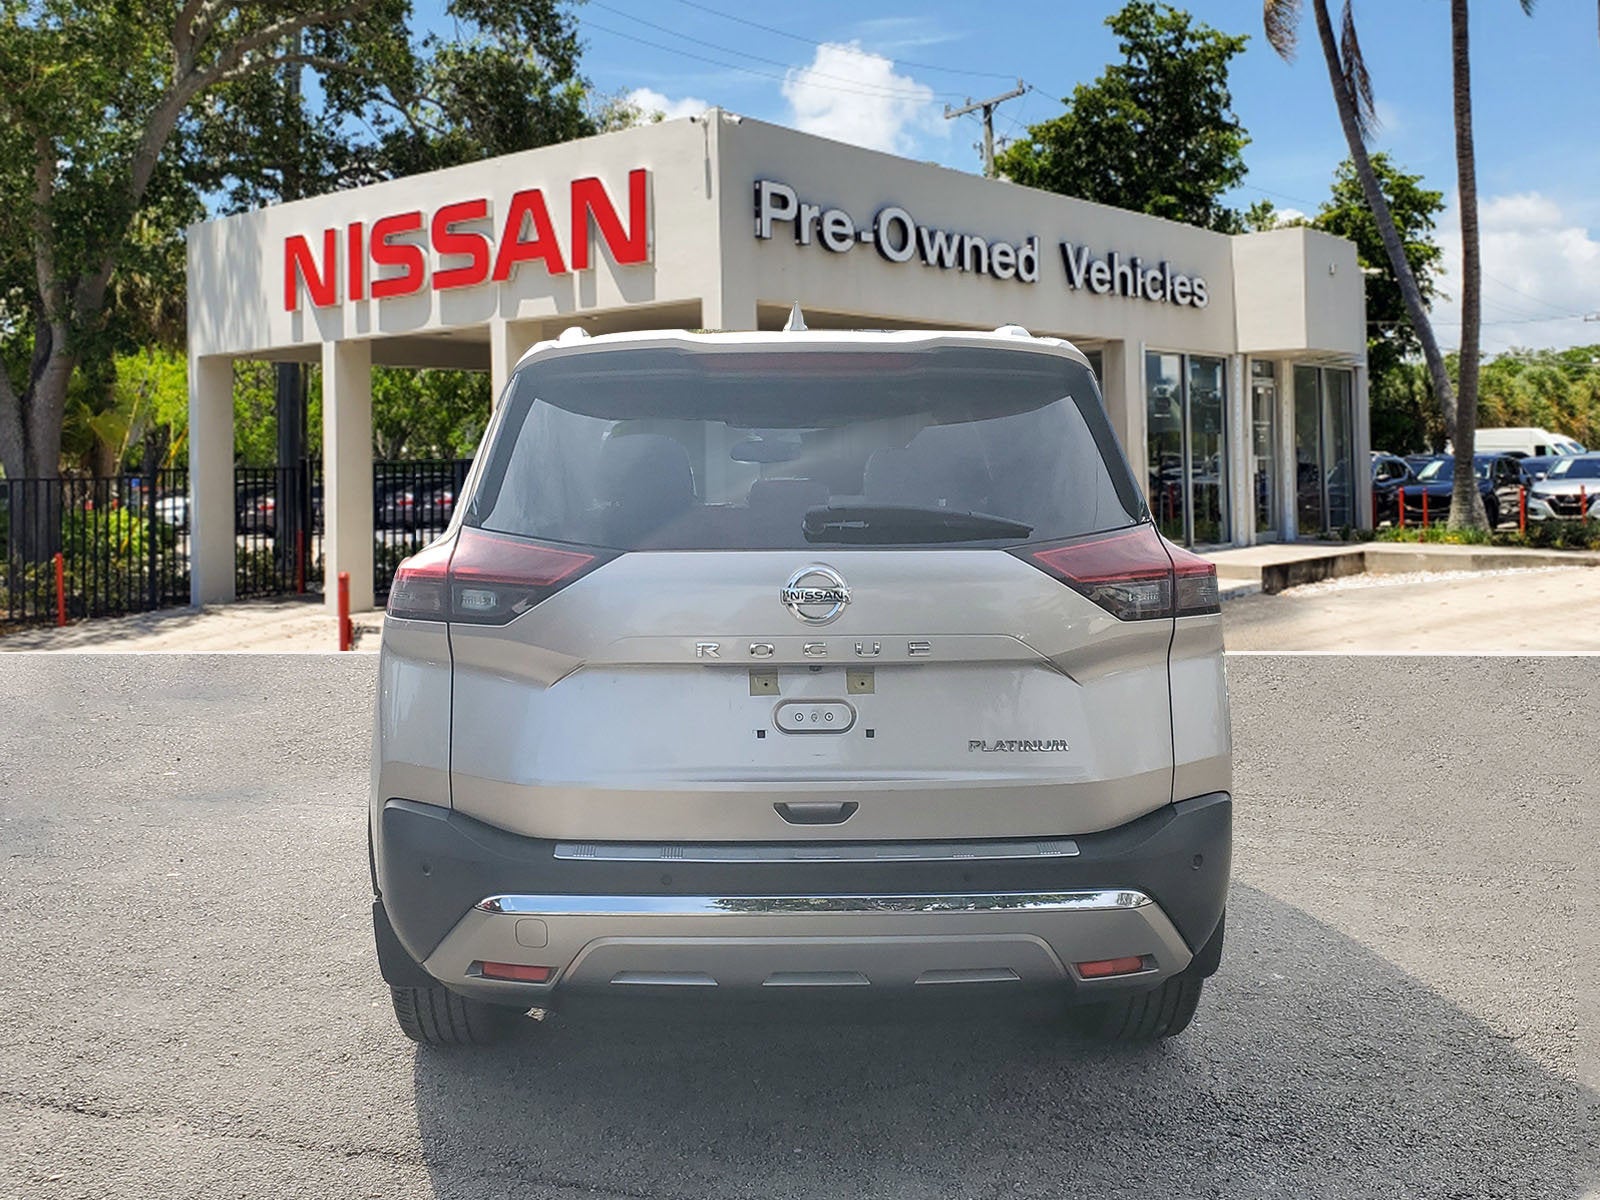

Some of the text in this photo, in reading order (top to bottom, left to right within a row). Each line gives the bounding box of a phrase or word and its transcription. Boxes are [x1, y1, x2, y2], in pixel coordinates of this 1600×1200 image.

[285, 168, 648, 312] NISSAN
[755, 180, 1209, 308] Pre-Owned Vehicles
[790, 590, 844, 601] NISSAN
[695, 640, 933, 659] ROGUE
[968, 739, 1069, 753] PLATINUM
